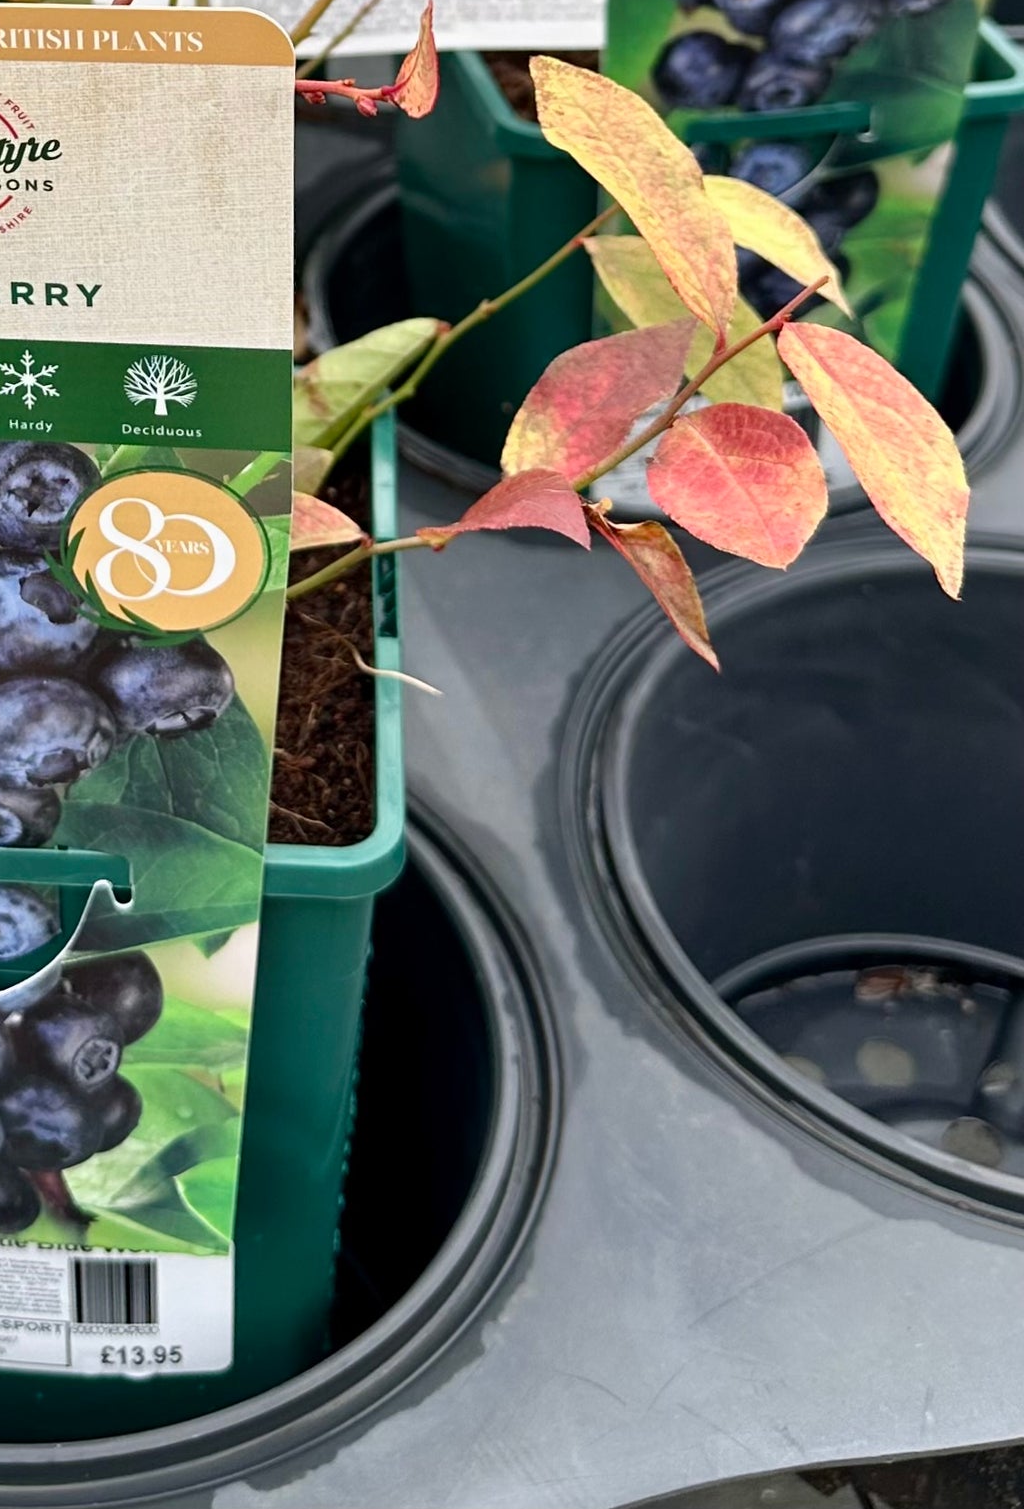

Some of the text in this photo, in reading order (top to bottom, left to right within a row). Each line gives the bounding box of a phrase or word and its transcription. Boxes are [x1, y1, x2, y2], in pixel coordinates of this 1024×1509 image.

[93, 29, 204, 53] PLANTS
[3, 99, 36, 131] FRUIT
[9, 419, 53, 433] Hardy
[122, 423, 202, 438] Deciduous
[95, 497, 236, 602] 80
[154, 539, 210, 555] YEARS
[101, 1345, 183, 1365] £13.95
